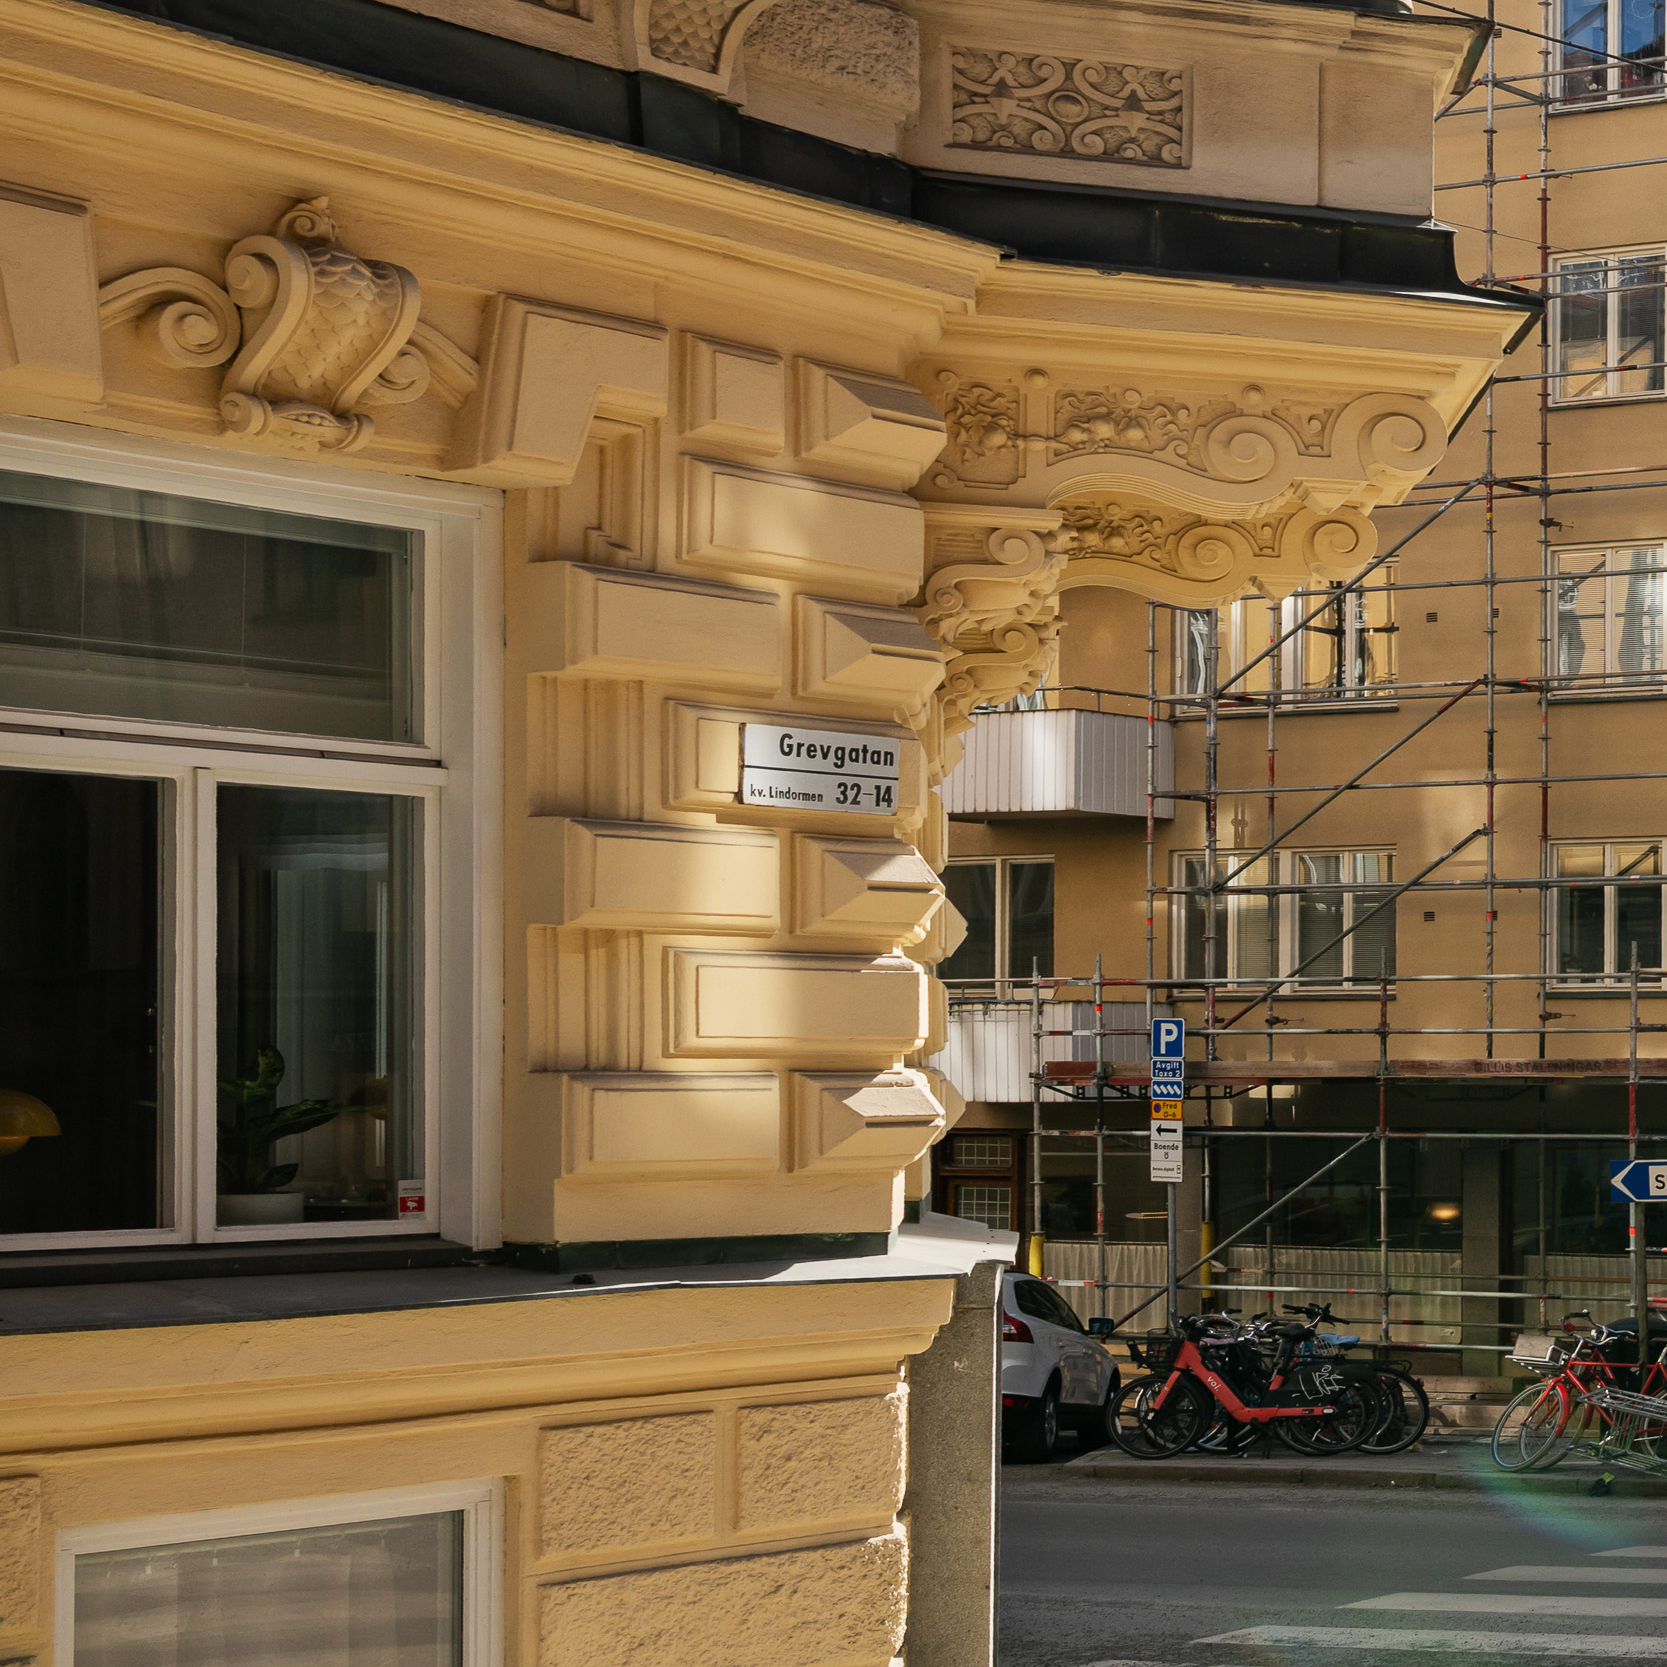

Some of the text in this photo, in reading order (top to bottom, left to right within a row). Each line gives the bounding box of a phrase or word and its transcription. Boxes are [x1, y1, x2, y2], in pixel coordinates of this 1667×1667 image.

[779, 733, 895, 769] Grevgatan
[750, 784, 766, 797] kv.
[769, 786, 823, 802] Lindormen
[1160, 1022, 1178, 1055] P
[1156, 1061, 1180, 1070] Avgift
[1154, 1069, 1173, 1077] Taxa
[1153, 1142, 1180, 1151] Boende
